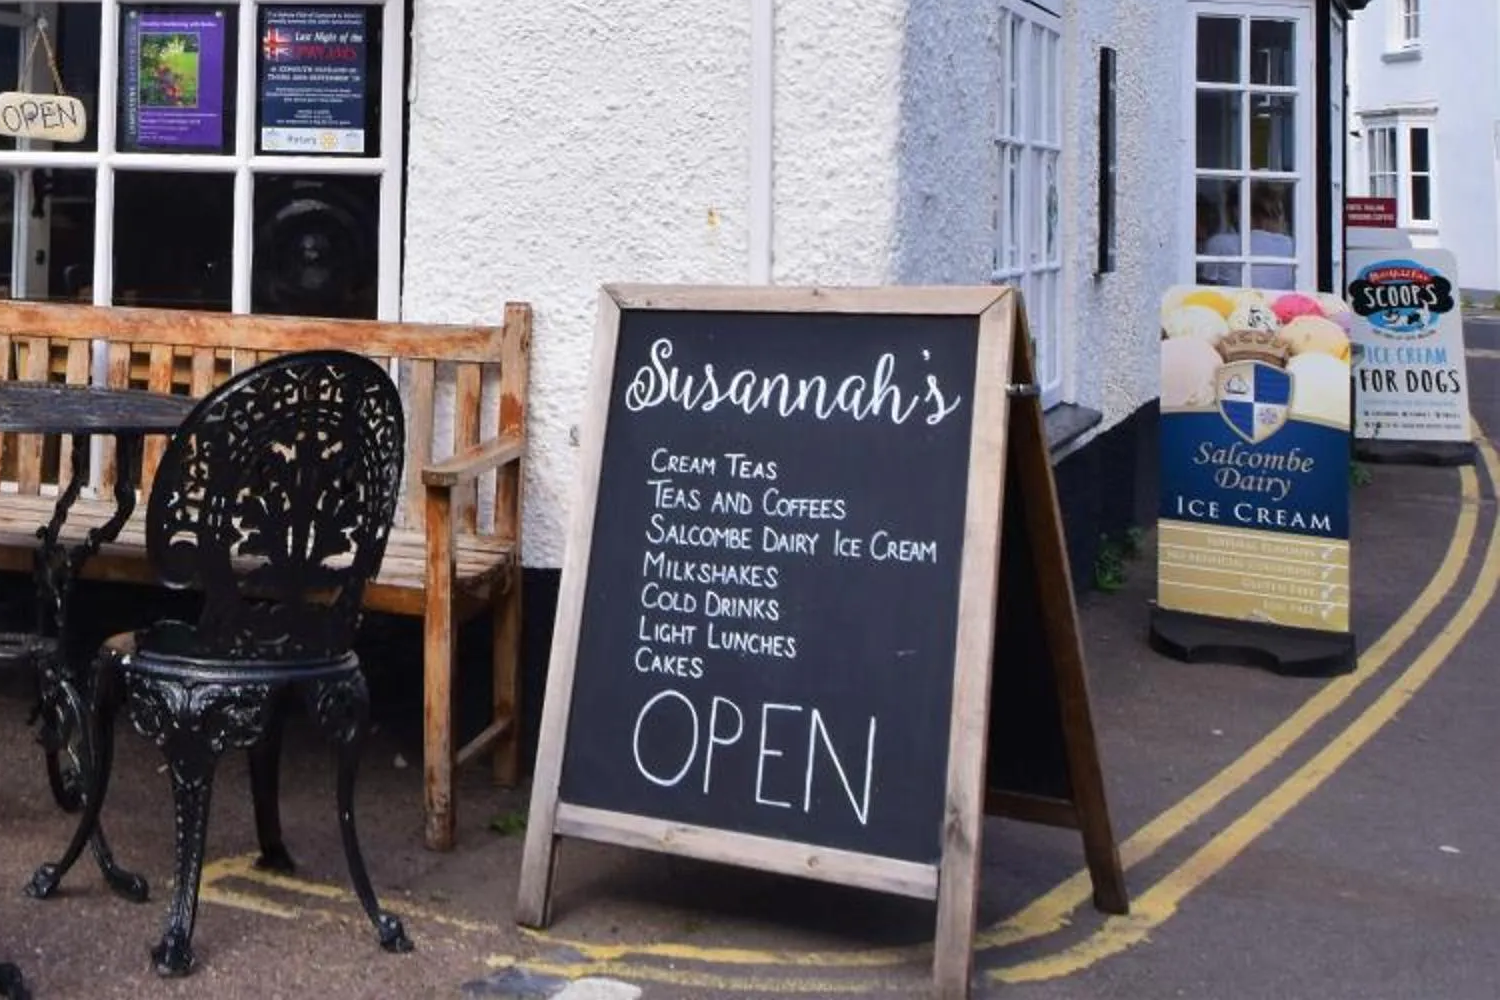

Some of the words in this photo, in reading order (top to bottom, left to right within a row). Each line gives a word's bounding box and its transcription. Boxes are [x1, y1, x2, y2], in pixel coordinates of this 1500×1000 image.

[1, 100, 78, 132] OPEN
[1366, 344, 1389, 364] ICE
[1396, 346, 1448, 366] CREAM
[625, 337, 961, 425] Susannah's
[1360, 368, 1399, 393] FOR
[1405, 368, 1461, 394] DOGS
[1193, 441, 1315, 473] Salcombe
[1214, 467, 1292, 502] Dairy
[1176, 495, 1221, 519] ICE
[1233, 503, 1333, 532] CREAM
[632, 689, 876, 826] OPEN
